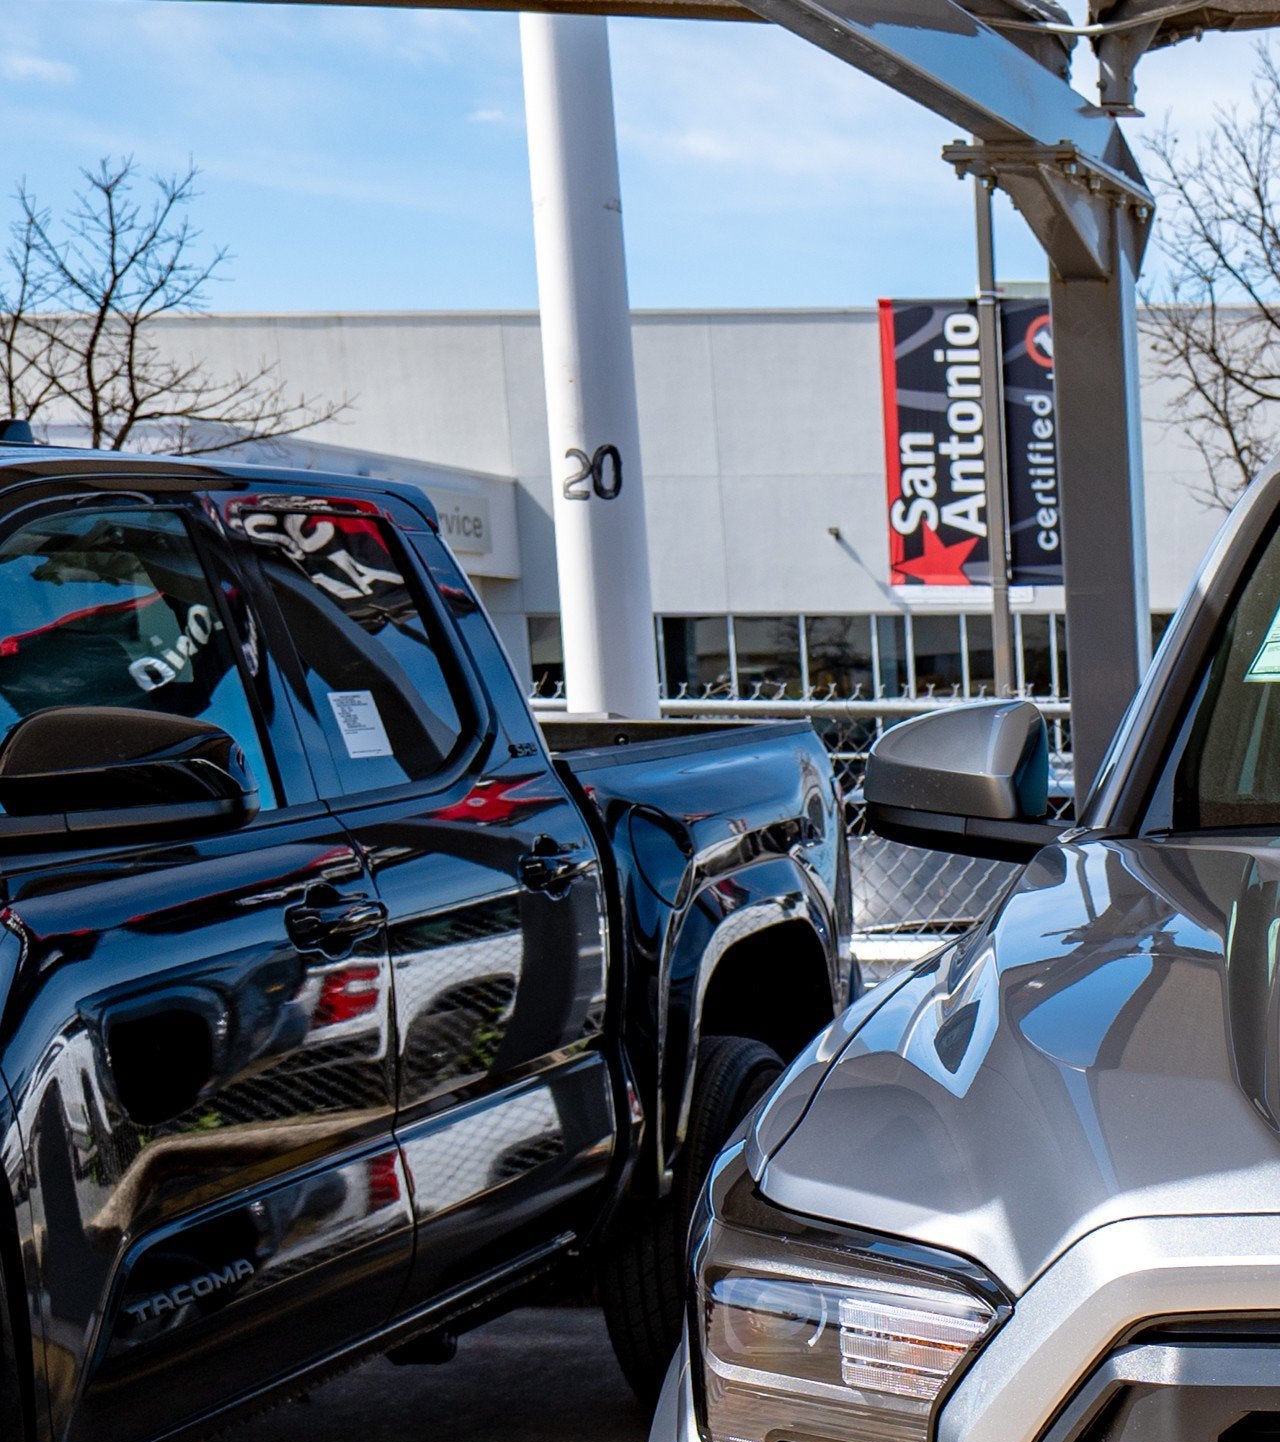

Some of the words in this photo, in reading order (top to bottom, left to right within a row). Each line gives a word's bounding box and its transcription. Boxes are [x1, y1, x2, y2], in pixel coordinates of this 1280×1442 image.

[563, 444, 622, 501] 20
[934, 313, 987, 538] Antonio
[1025, 394, 1059, 551] certified
[890, 431, 939, 536] San
[124, 1258, 255, 1322] TACOMA
